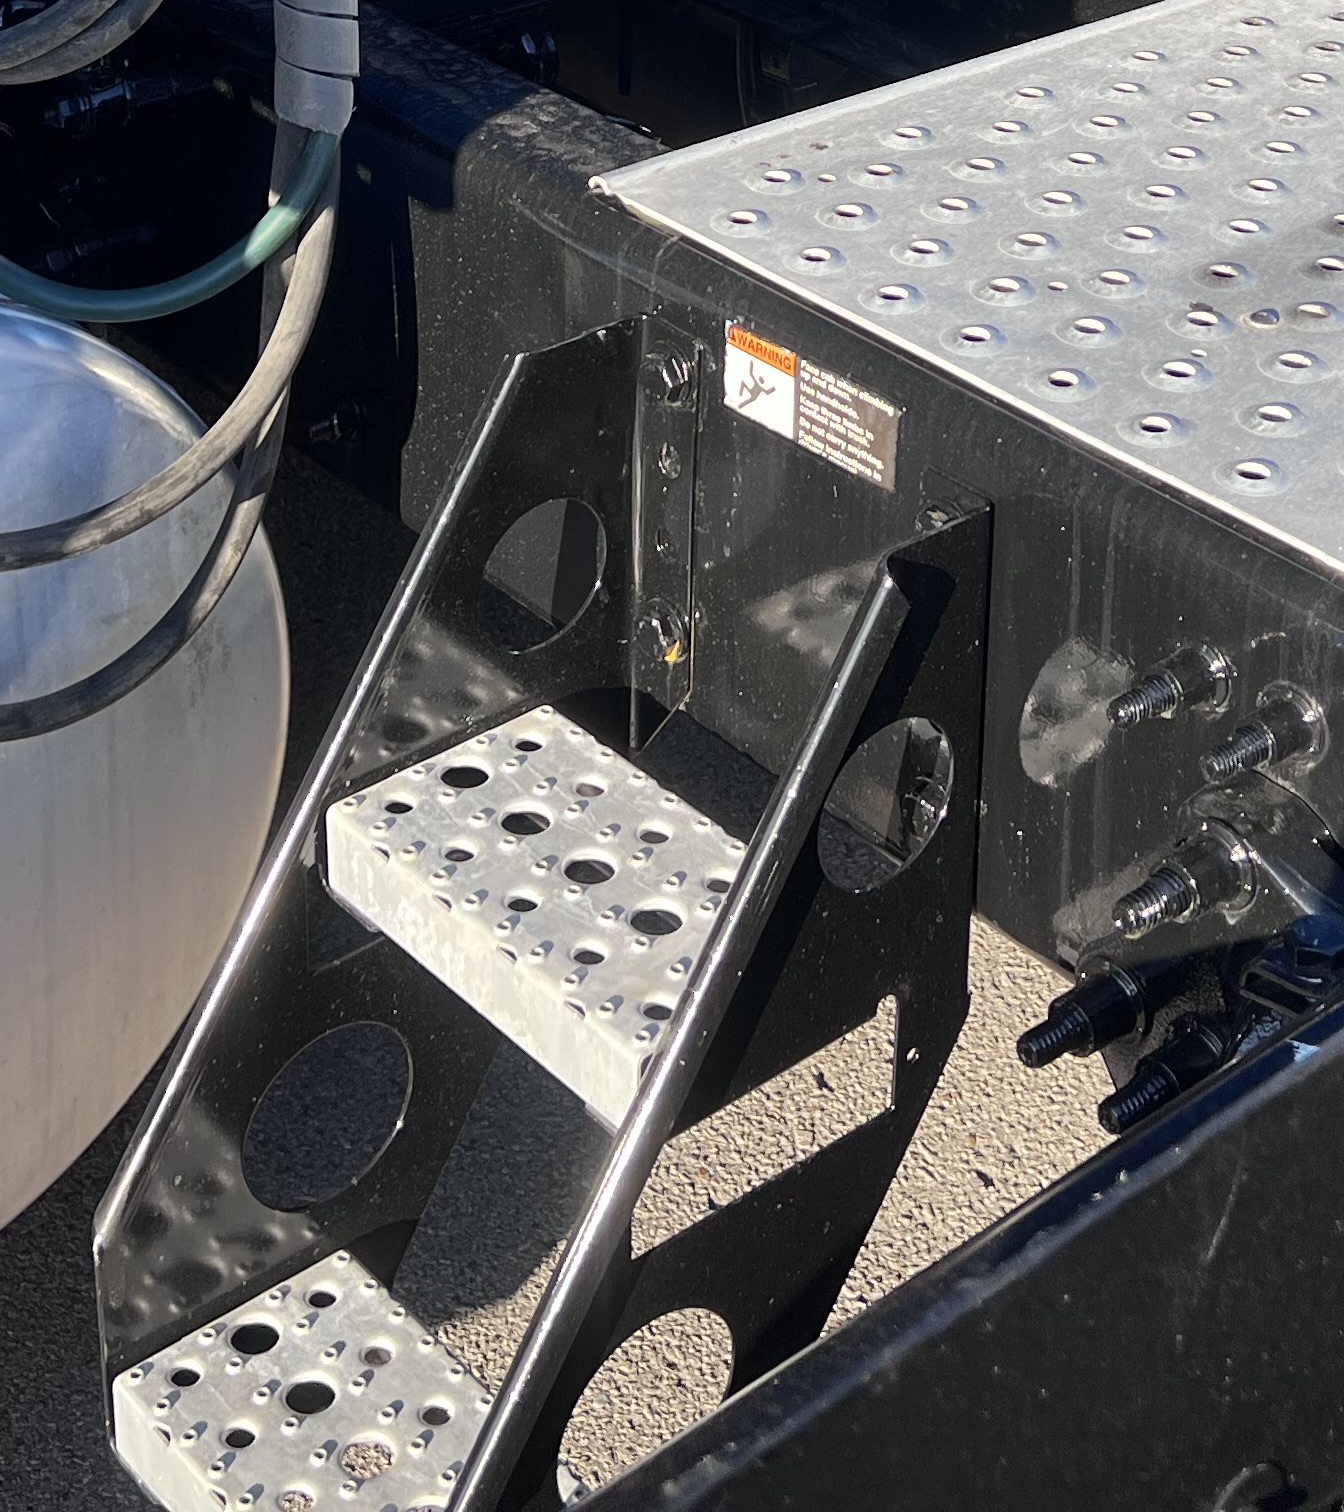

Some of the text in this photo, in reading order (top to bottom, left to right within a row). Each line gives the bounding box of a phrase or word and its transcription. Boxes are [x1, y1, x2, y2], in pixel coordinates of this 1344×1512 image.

[737, 334, 792, 370] WARNING
[799, 359, 895, 417] Face cab when climbing
[800, 369, 852, 403] up and down.
[800, 382, 816, 397] Use
[799, 394, 820, 412] Keep
[820, 407, 842, 424] three
[799, 405, 829, 426] contact
[829, 421, 847, 436] with
[798, 430, 825, 450] Follow
[825, 444, 873, 477] instructions
[873, 471, 883, 483] in
[799, 416, 811, 430] Do
[811, 425, 825, 438] not
[826, 433, 847, 450] carry
[847, 443, 885, 470] anything.
